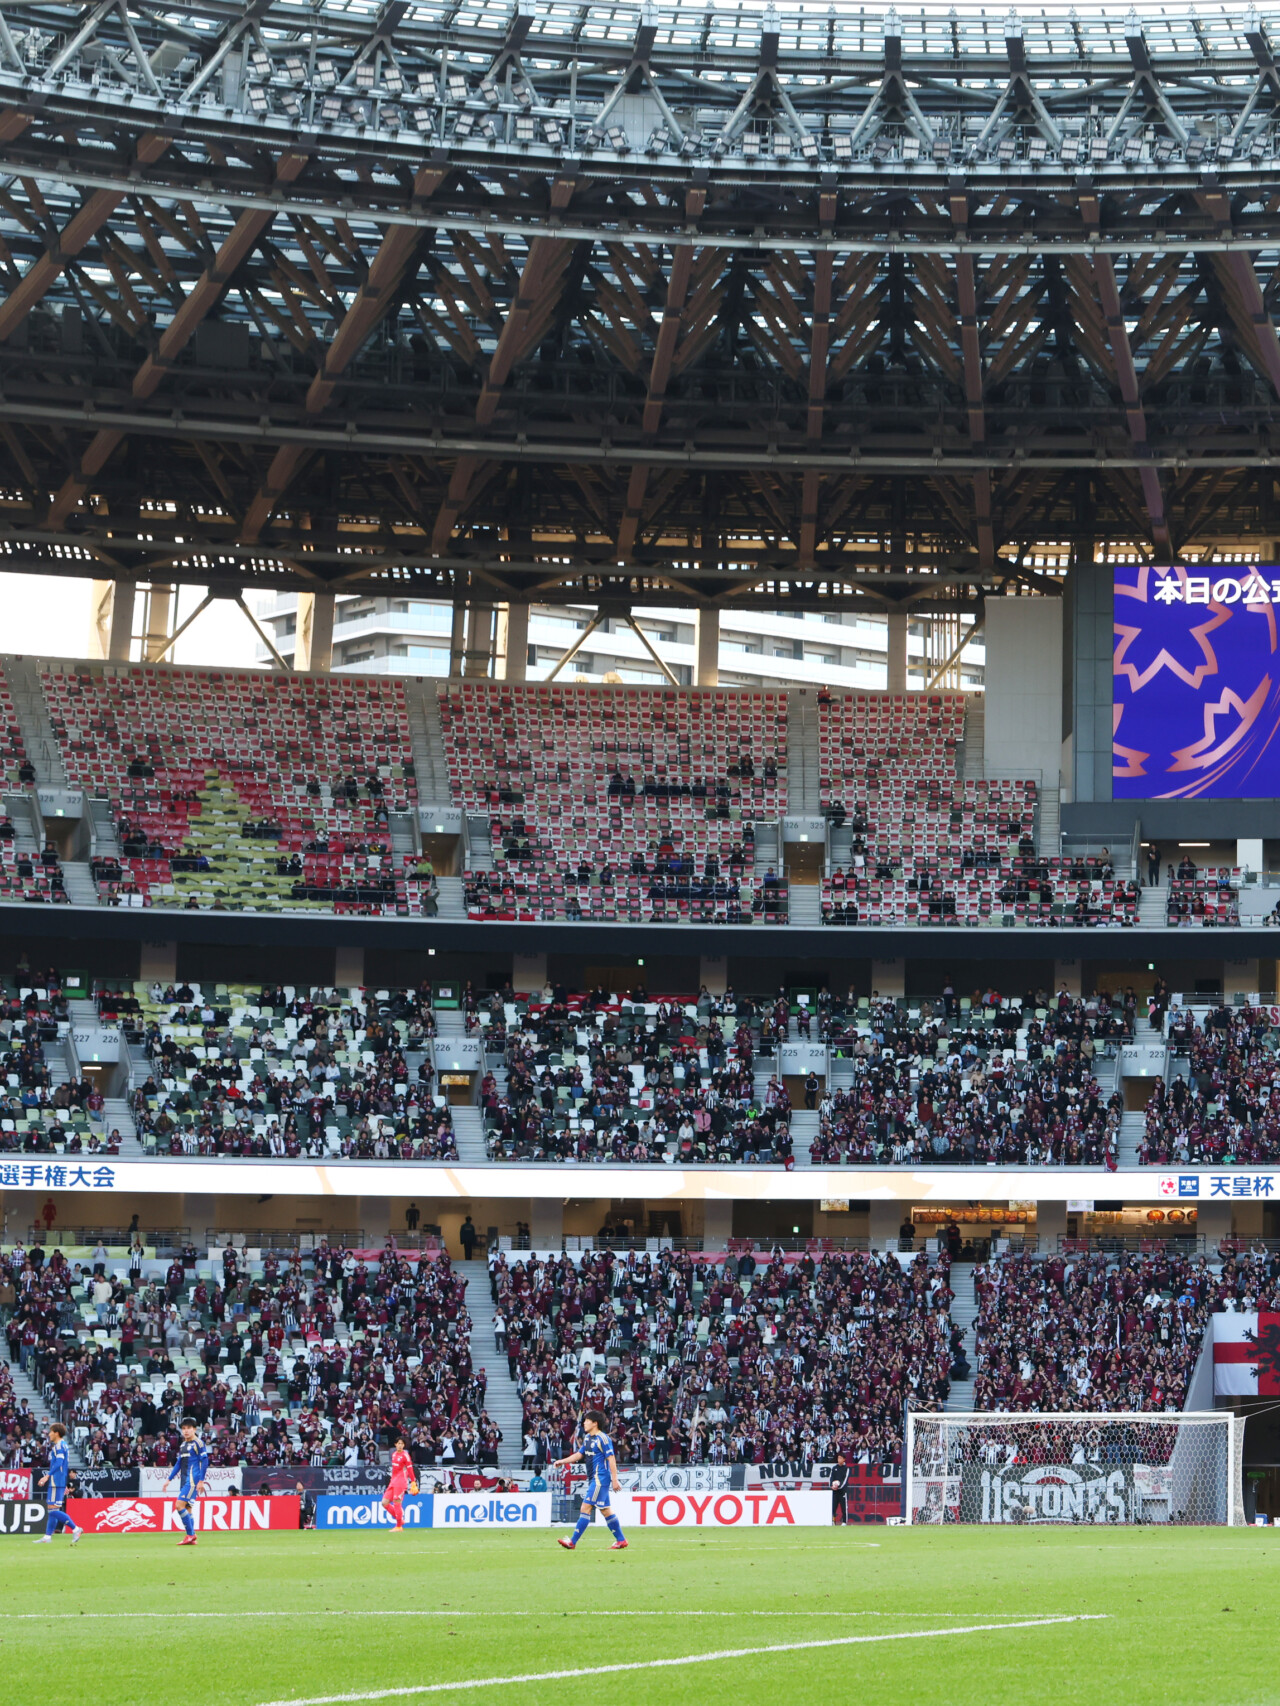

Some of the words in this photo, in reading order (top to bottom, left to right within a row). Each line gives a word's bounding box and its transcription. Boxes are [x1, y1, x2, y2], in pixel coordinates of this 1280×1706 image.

[420, 812, 434, 820] 327
[74, 1035, 90, 1043] 227
[435, 1044, 451, 1052] 226
[0, 1165, 115, 1188] 選手権大会
[1211, 1177, 1274, 1197] 天皇杯
[323, 1468, 359, 1481] KEEP
[637, 1466, 732, 1492] KOBE
[759, 1464, 812, 1479] NOW
[820, 1465, 859, 1478] ad
[162, 1500, 271, 1531] KIRIN
[444, 1500, 537, 1523] molten
[632, 1494, 796, 1526] TOYOTA
